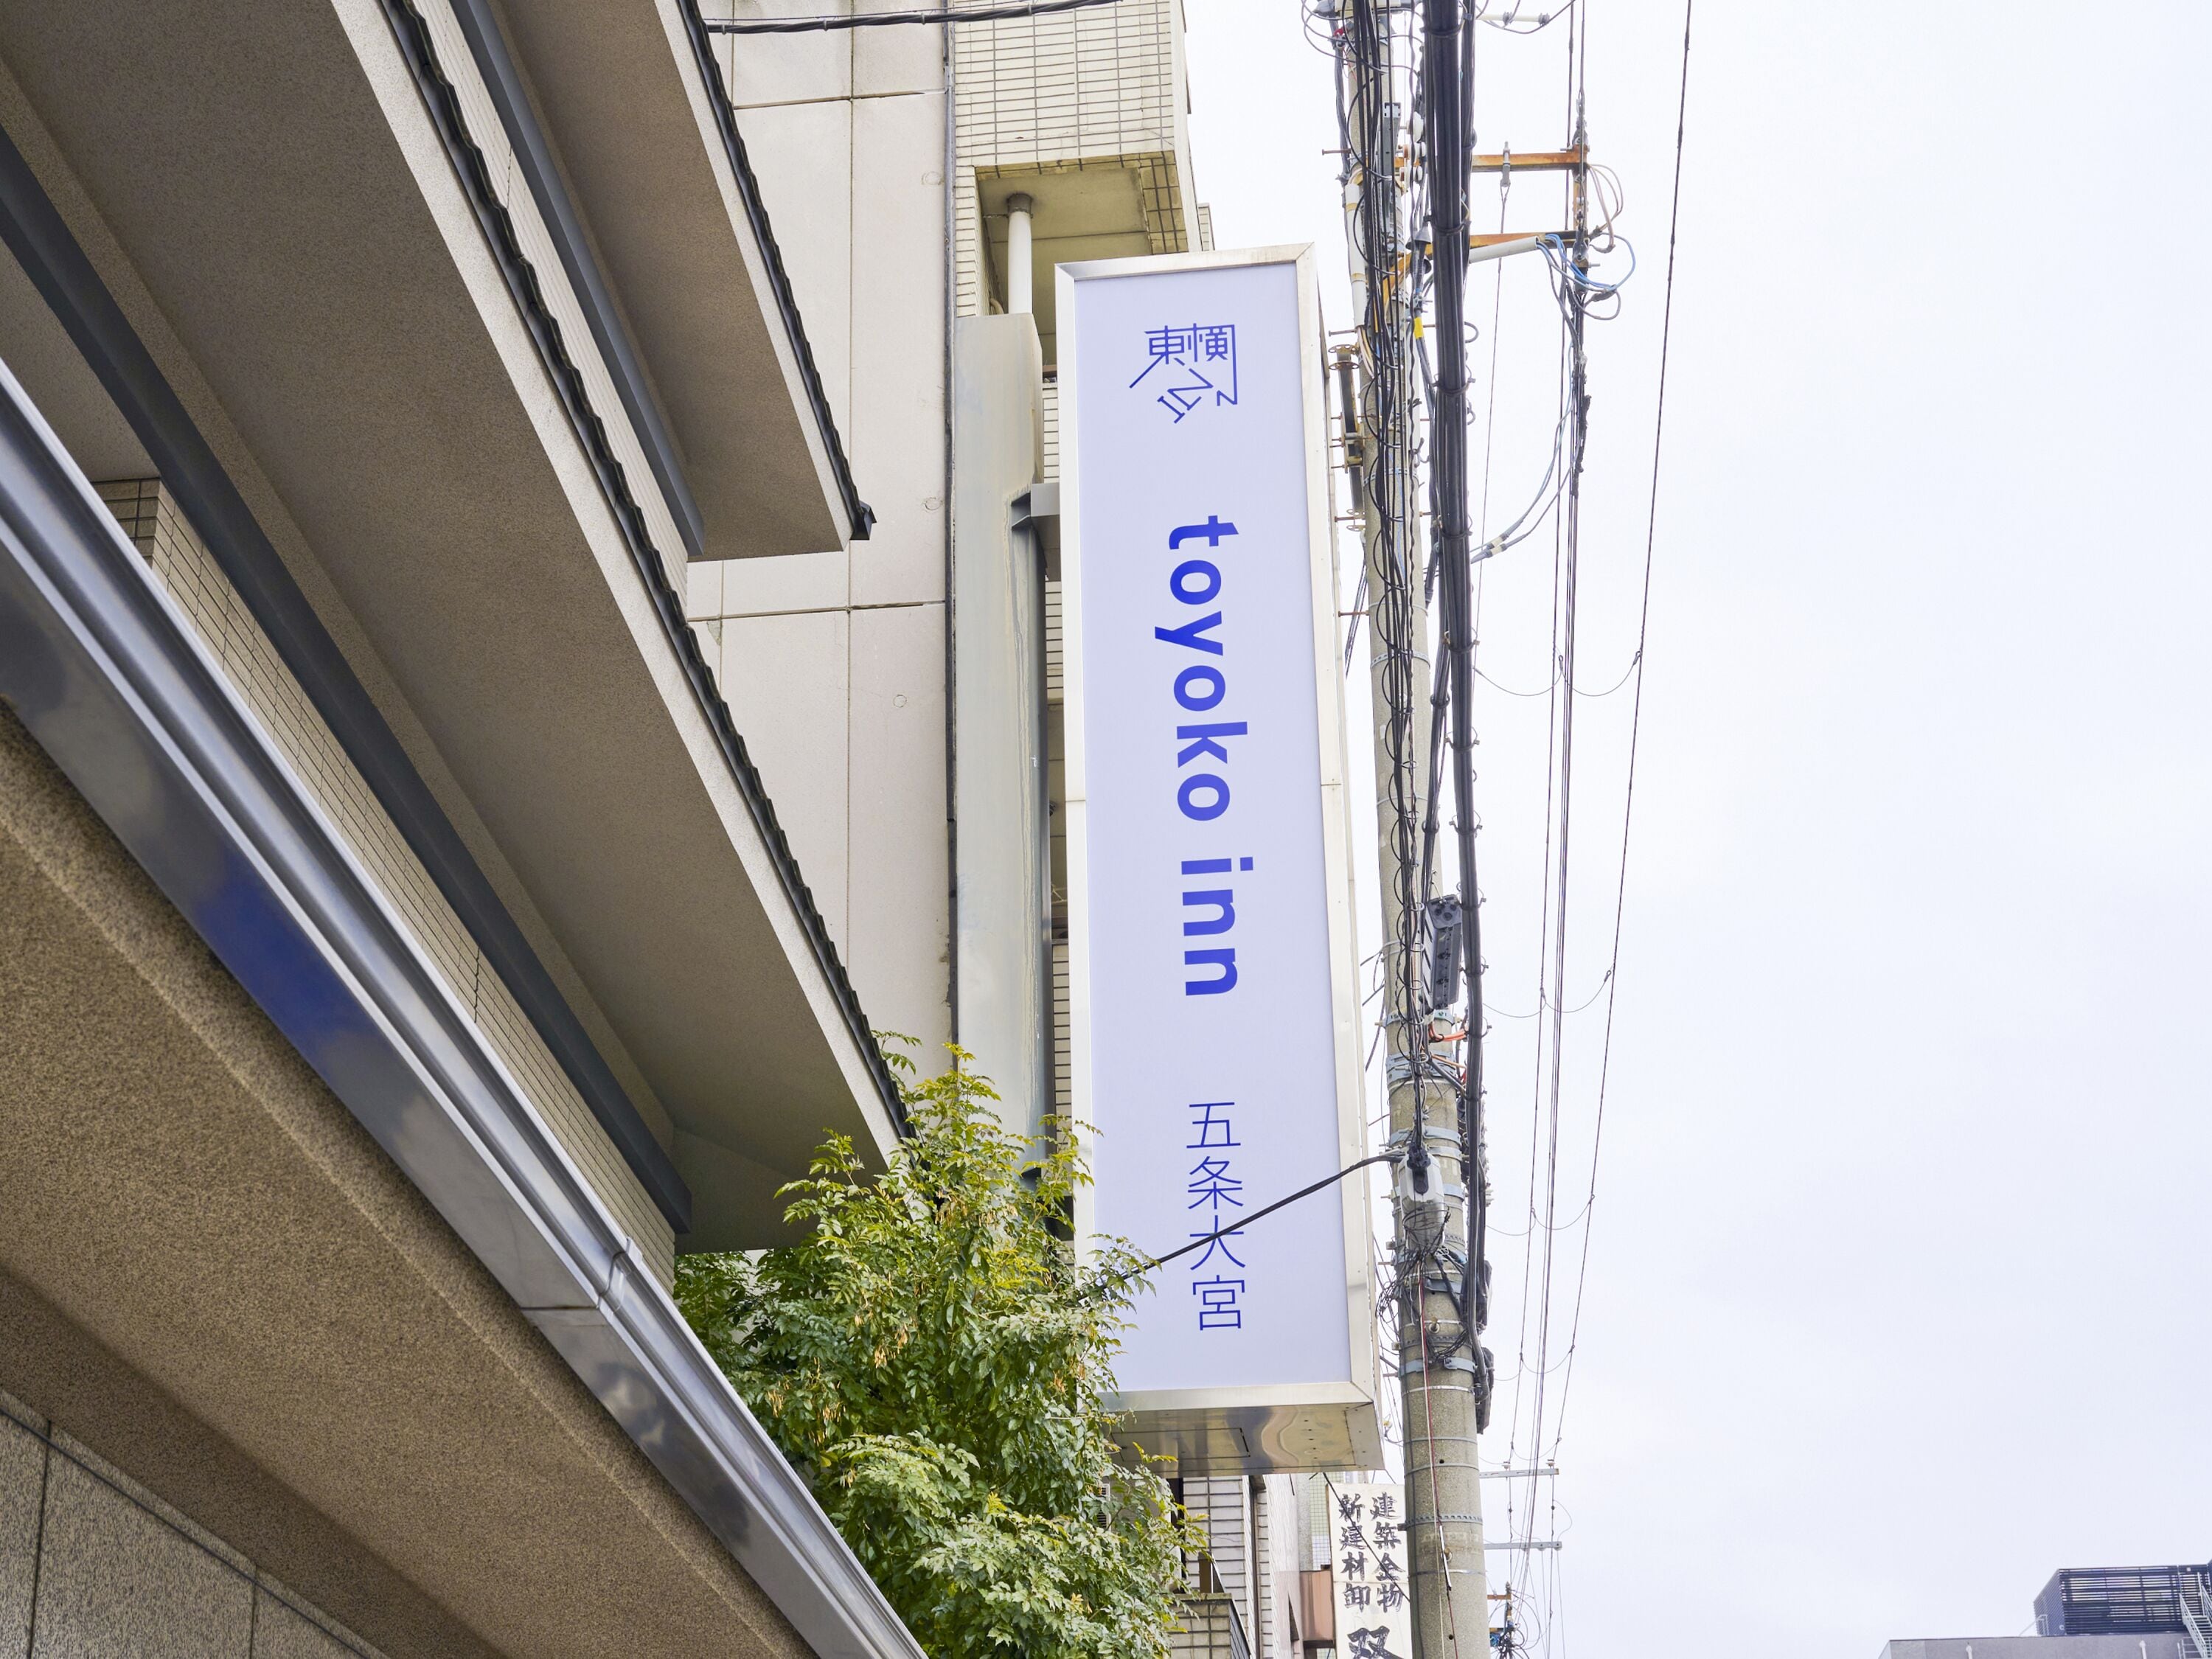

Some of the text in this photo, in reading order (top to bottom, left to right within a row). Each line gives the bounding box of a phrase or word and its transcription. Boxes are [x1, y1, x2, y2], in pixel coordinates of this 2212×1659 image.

[1155, 515, 1253, 995] toyoko inn
[1186, 1102, 1246, 1332] 五条大宮
[1338, 1493, 1371, 1613] 新建材卸
[1369, 1492, 1405, 1613] 建築金物
